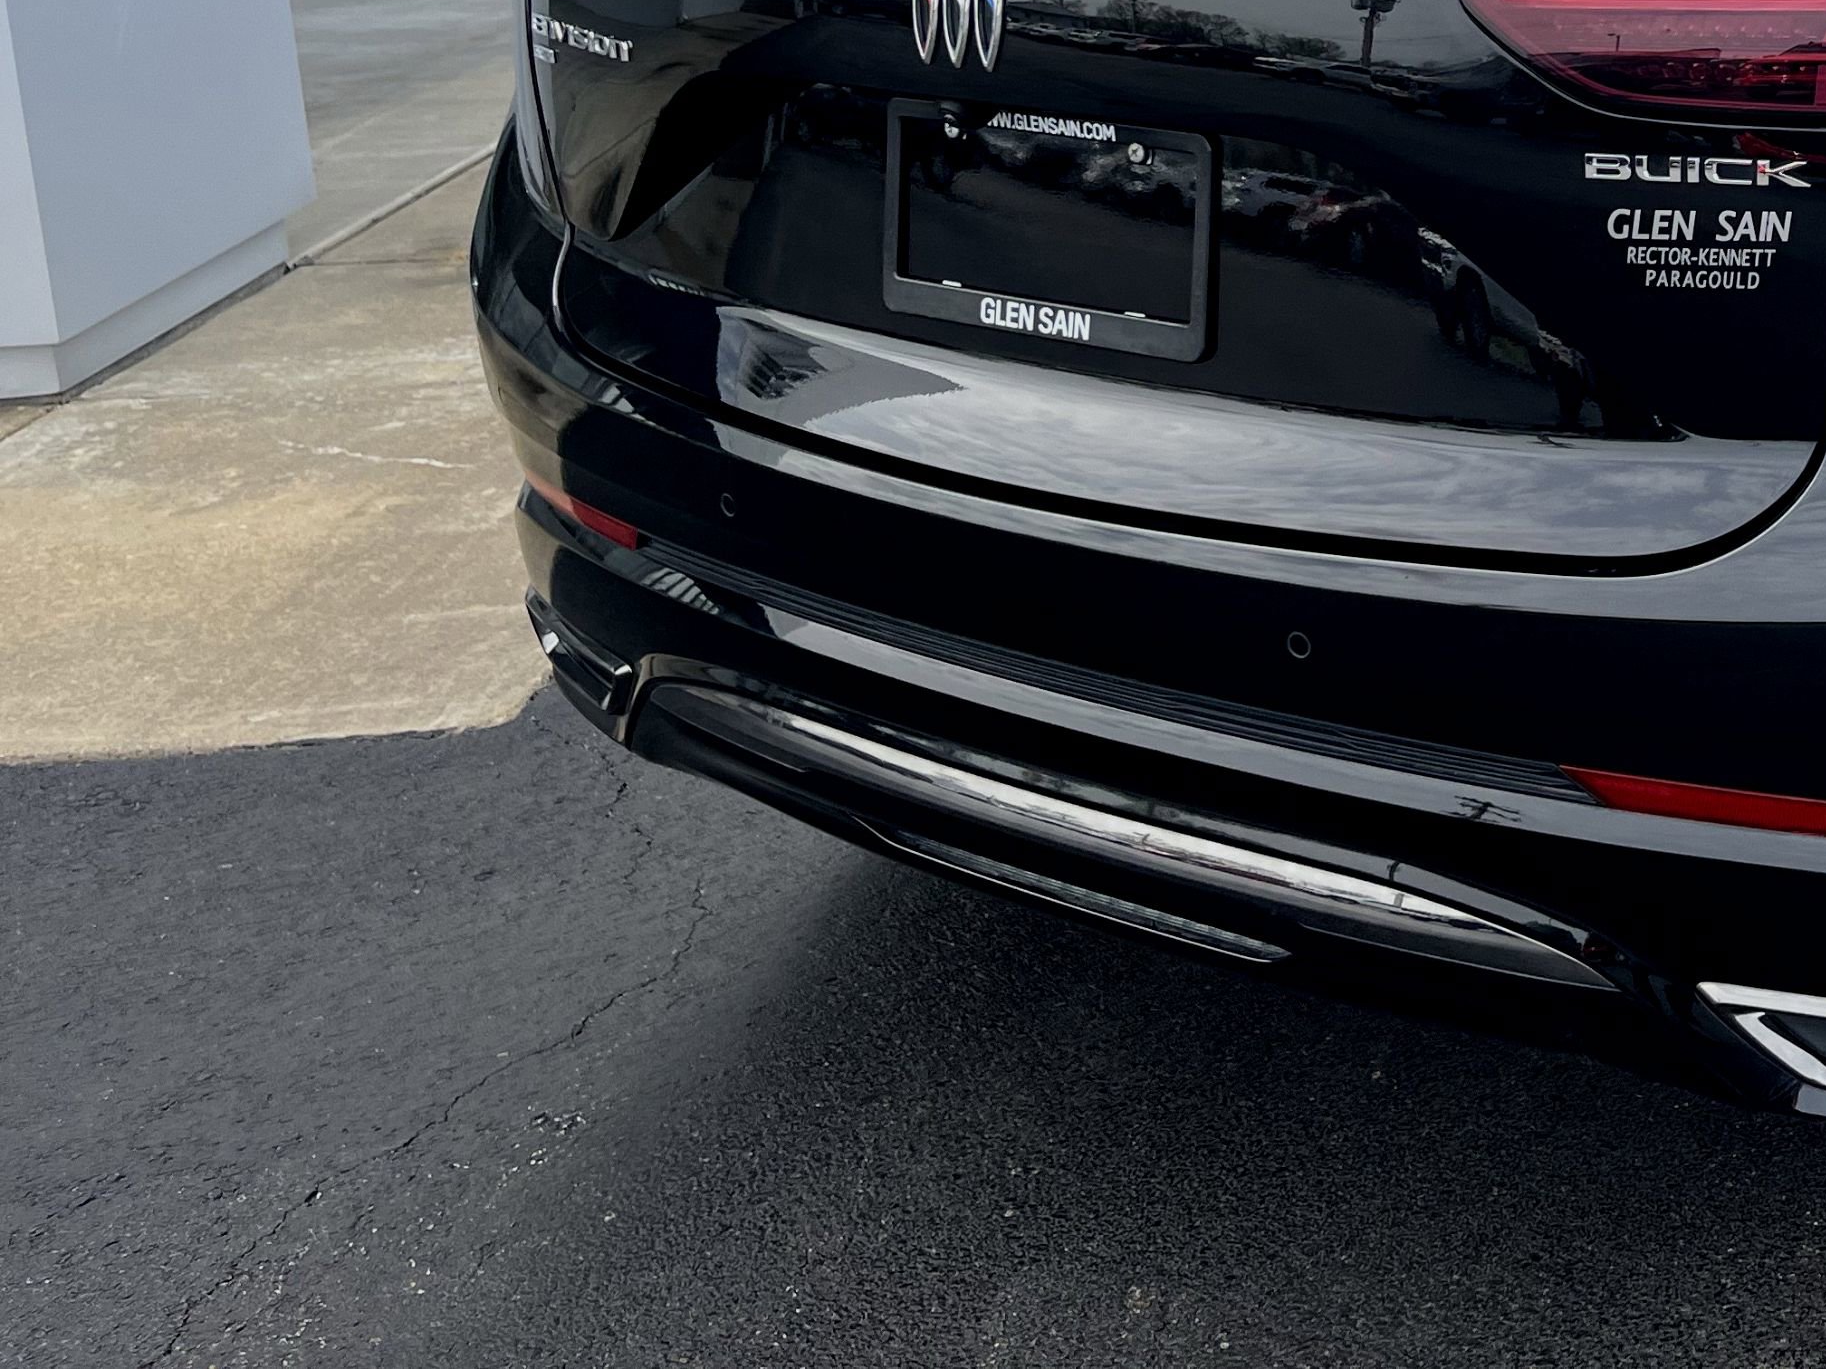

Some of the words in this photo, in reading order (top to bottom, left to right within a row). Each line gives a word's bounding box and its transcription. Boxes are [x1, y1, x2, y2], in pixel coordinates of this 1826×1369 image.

[987, 111, 1117, 142] WW.GLENSAIN.COM
[1585, 153, 1811, 188] BUICK
[1607, 208, 1696, 241] GLEN
[1715, 210, 1793, 242] SAIN
[1626, 246, 1777, 268] RECTOR-KENNETT
[1645, 269, 1760, 290] PARAGOULD
[980, 297, 1035, 331] GLEN
[1038, 306, 1091, 341] SAIN
